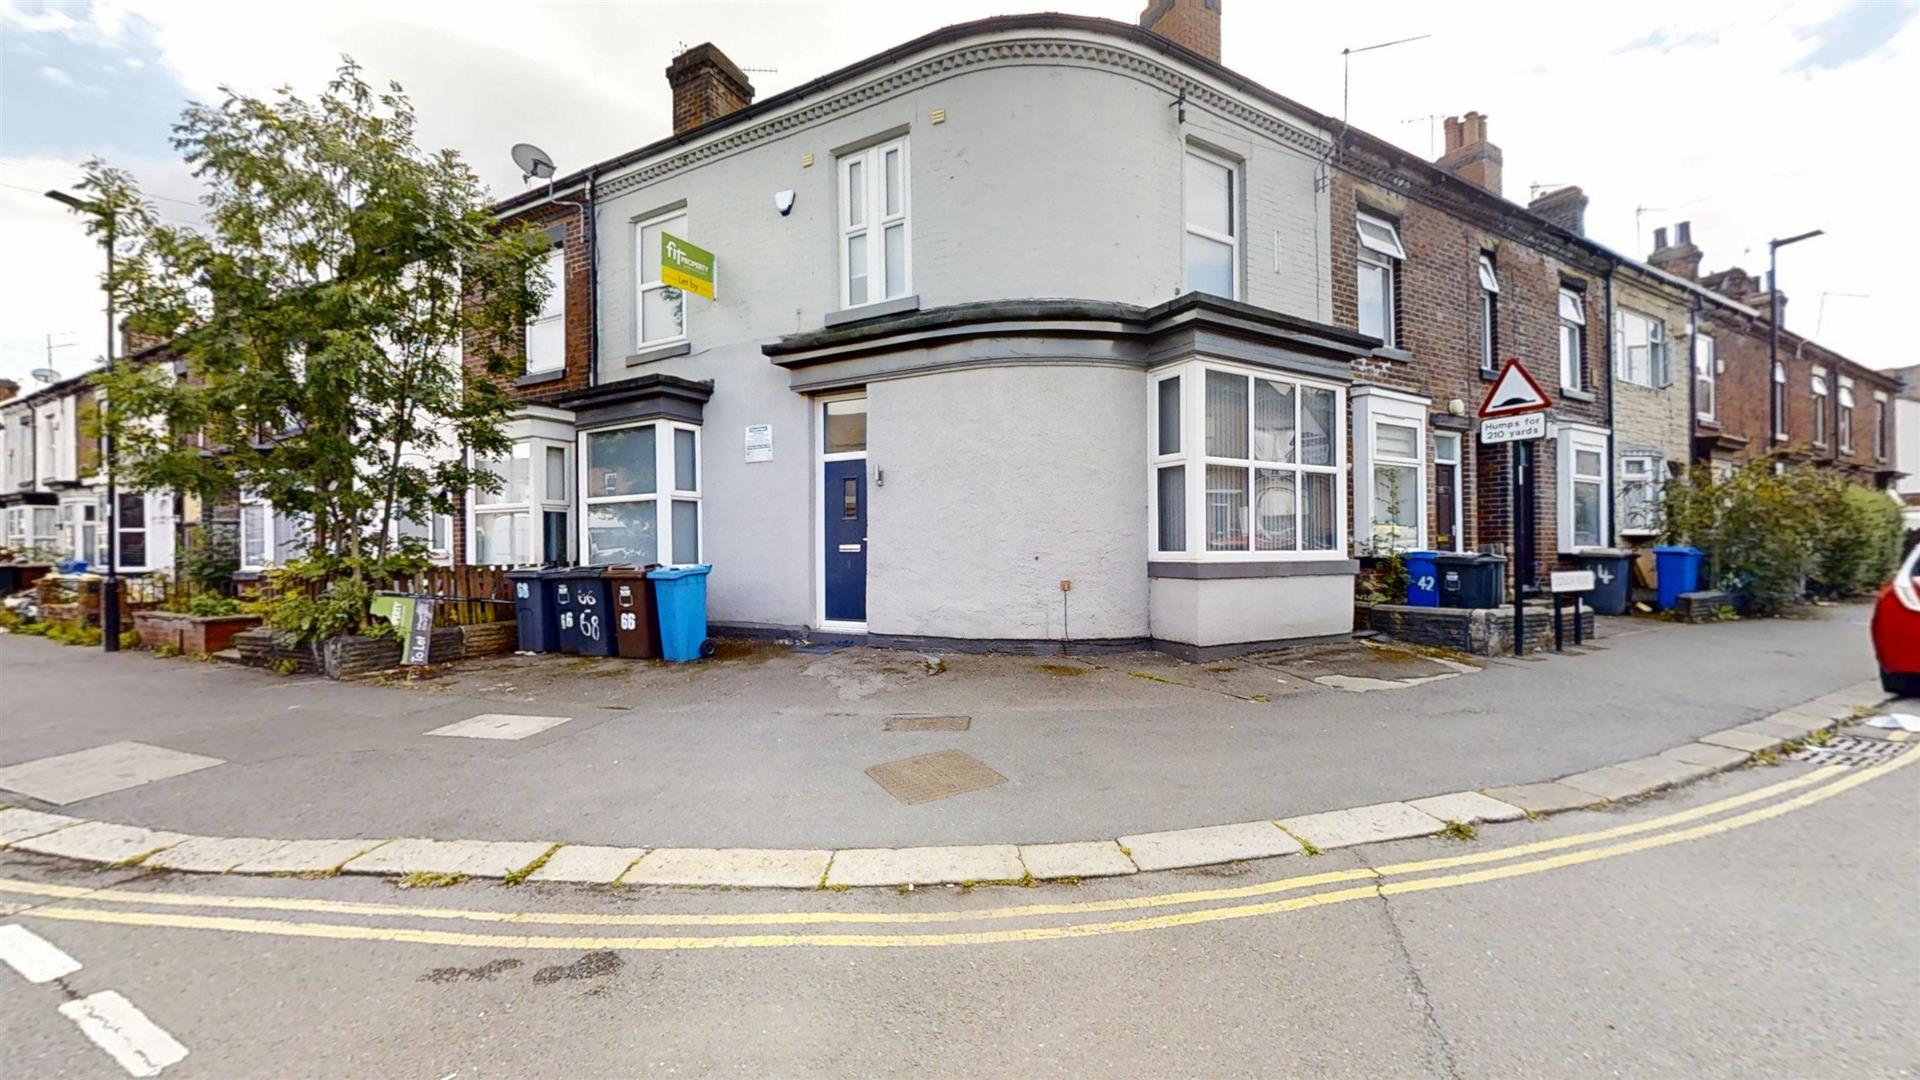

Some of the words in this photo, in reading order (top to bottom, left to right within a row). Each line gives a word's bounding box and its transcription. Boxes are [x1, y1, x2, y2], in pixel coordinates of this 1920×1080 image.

[678, 275, 688, 285] Let
[690, 279, 699, 292] by
[1485, 421, 1520, 432] Humps
[1525, 418, 1540, 426] for
[1487, 431, 1505, 440] 210
[1509, 427, 1538, 437] yards
[1417, 575, 1435, 591] 42
[579, 609, 600, 641] 68
[620, 612, 636, 631] 66
[413, 635, 427, 651] Let
[410, 651, 425, 664] To
